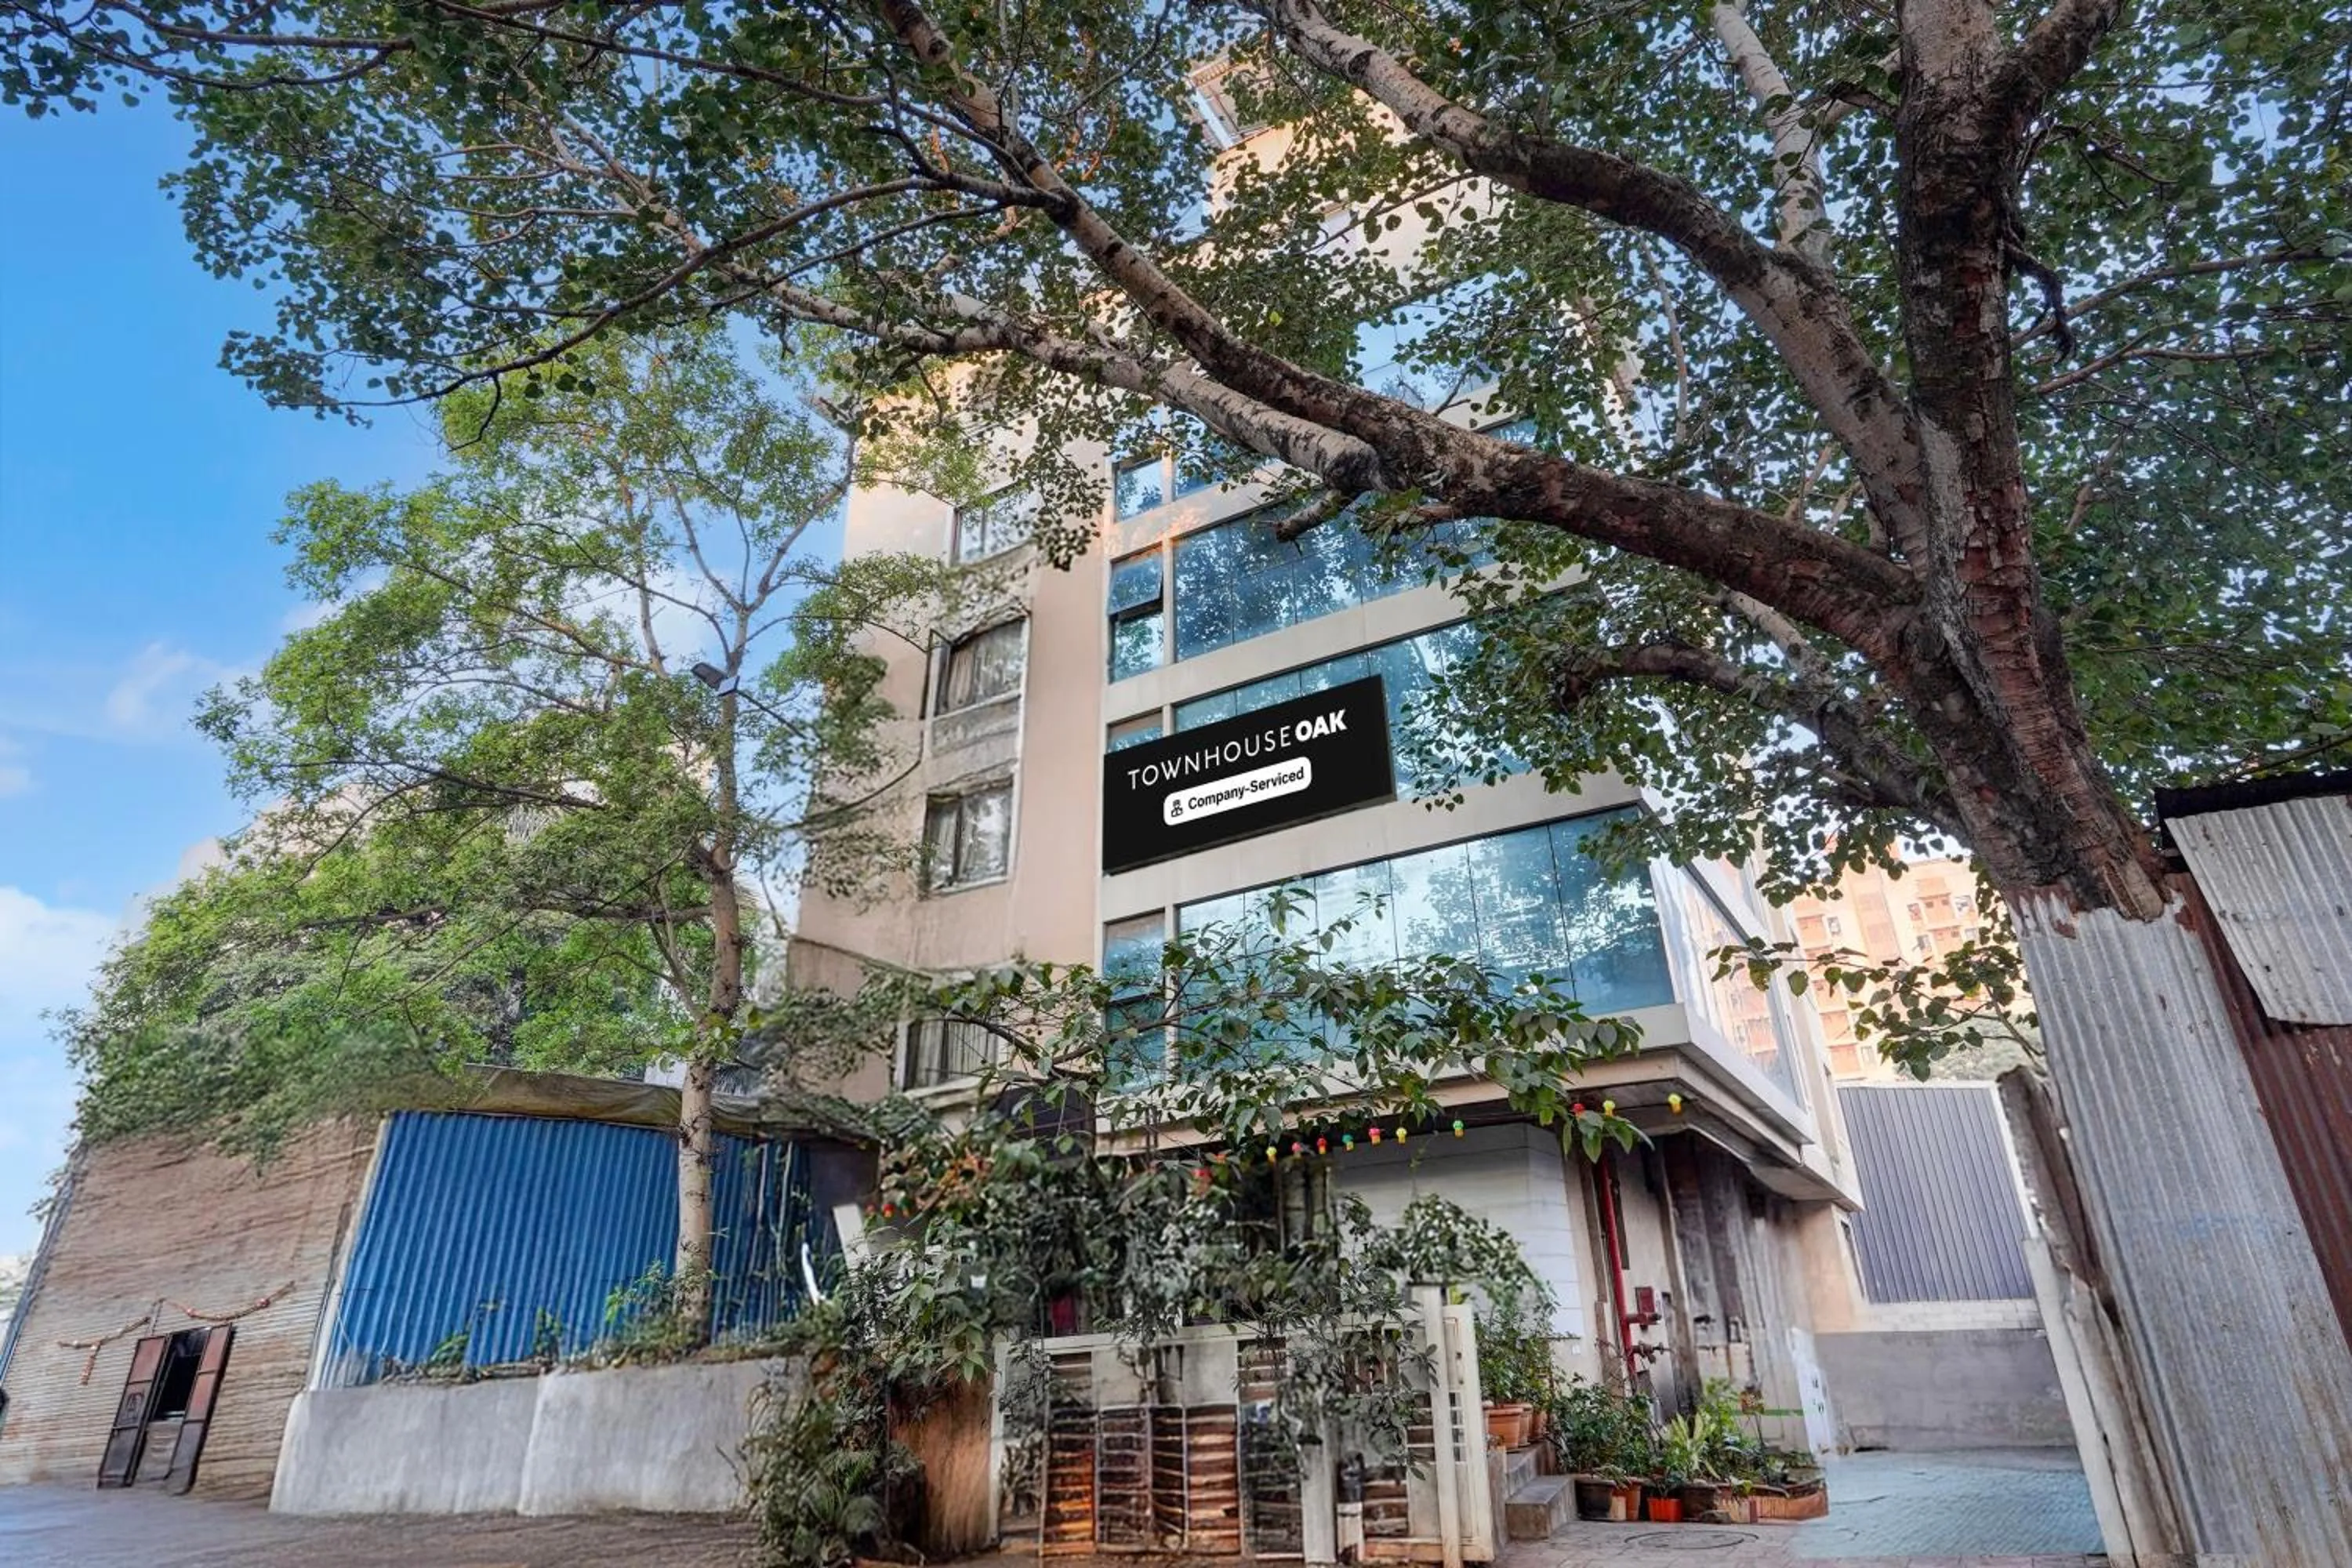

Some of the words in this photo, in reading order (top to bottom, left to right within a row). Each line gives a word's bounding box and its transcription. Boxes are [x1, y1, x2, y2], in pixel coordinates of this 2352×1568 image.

[1127, 725, 1292, 790] TOWNHOUSE
[1294, 709, 1348, 742] OAK
[1188, 767, 1305, 811] Company-Serviced
